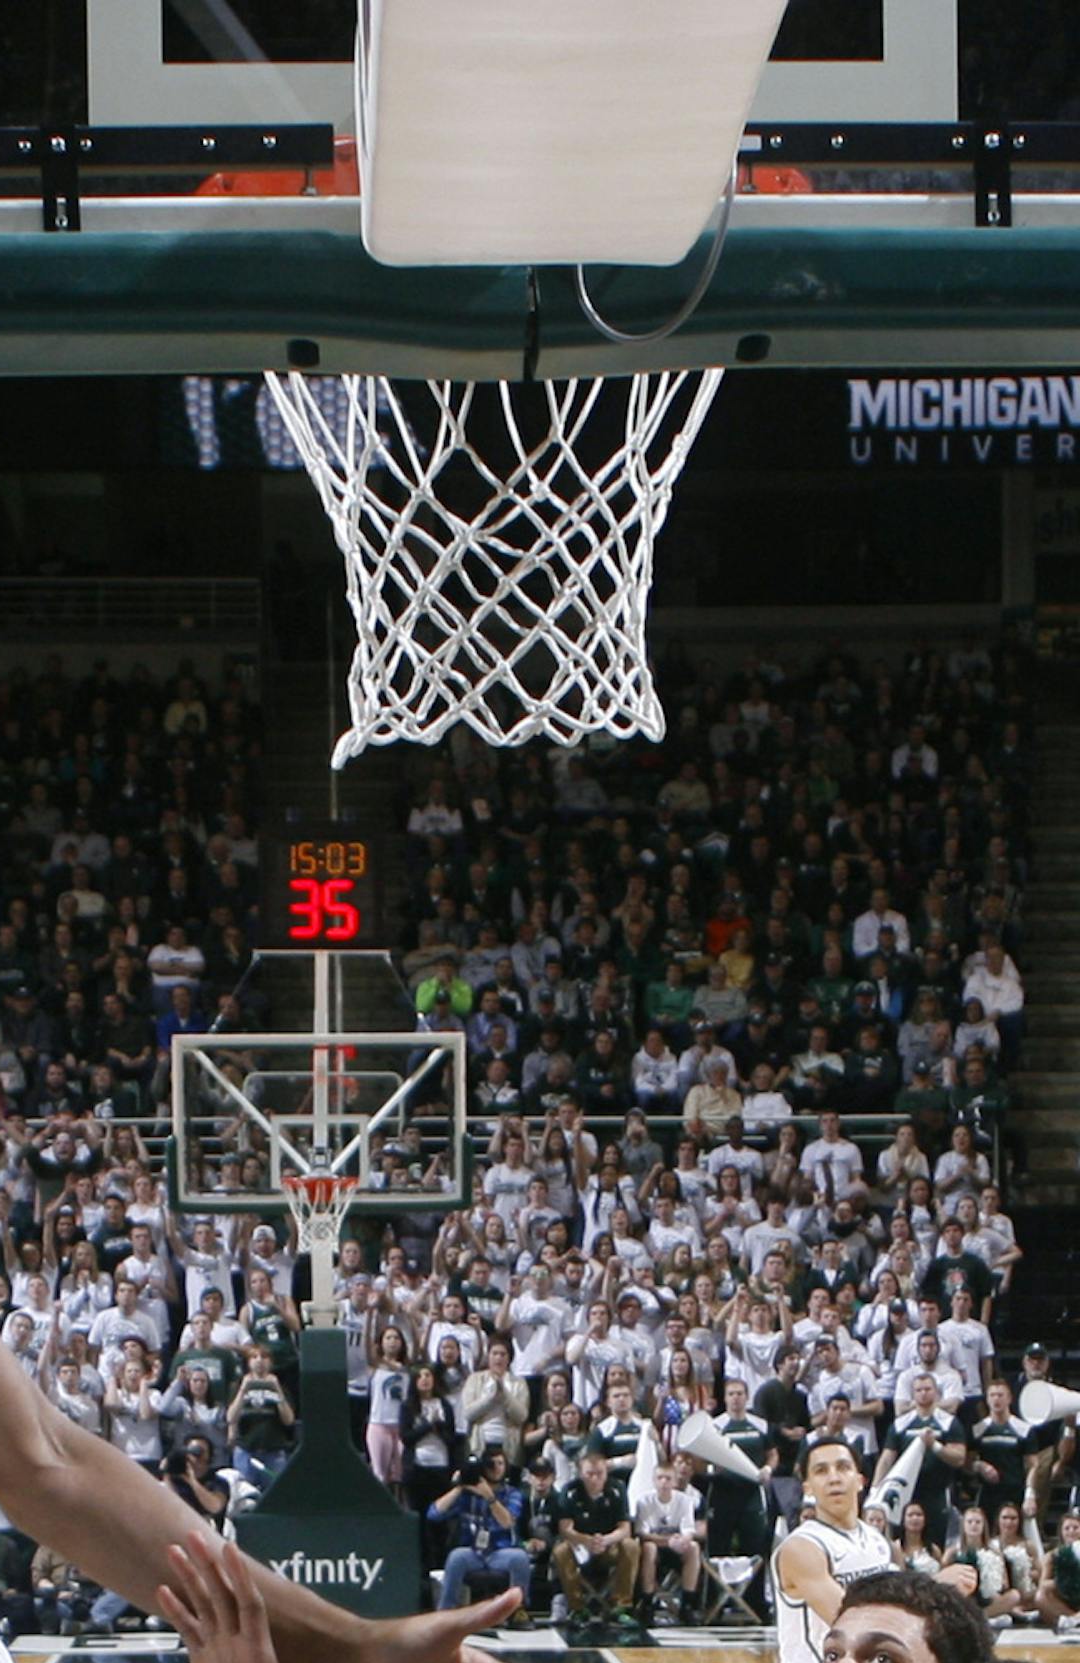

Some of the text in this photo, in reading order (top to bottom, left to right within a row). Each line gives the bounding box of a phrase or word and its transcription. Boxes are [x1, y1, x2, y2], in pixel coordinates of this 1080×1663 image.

[290, 842, 366, 875] 15:03
[289, 879, 360, 940] 35
[270, 1551, 384, 1590] xfinity
